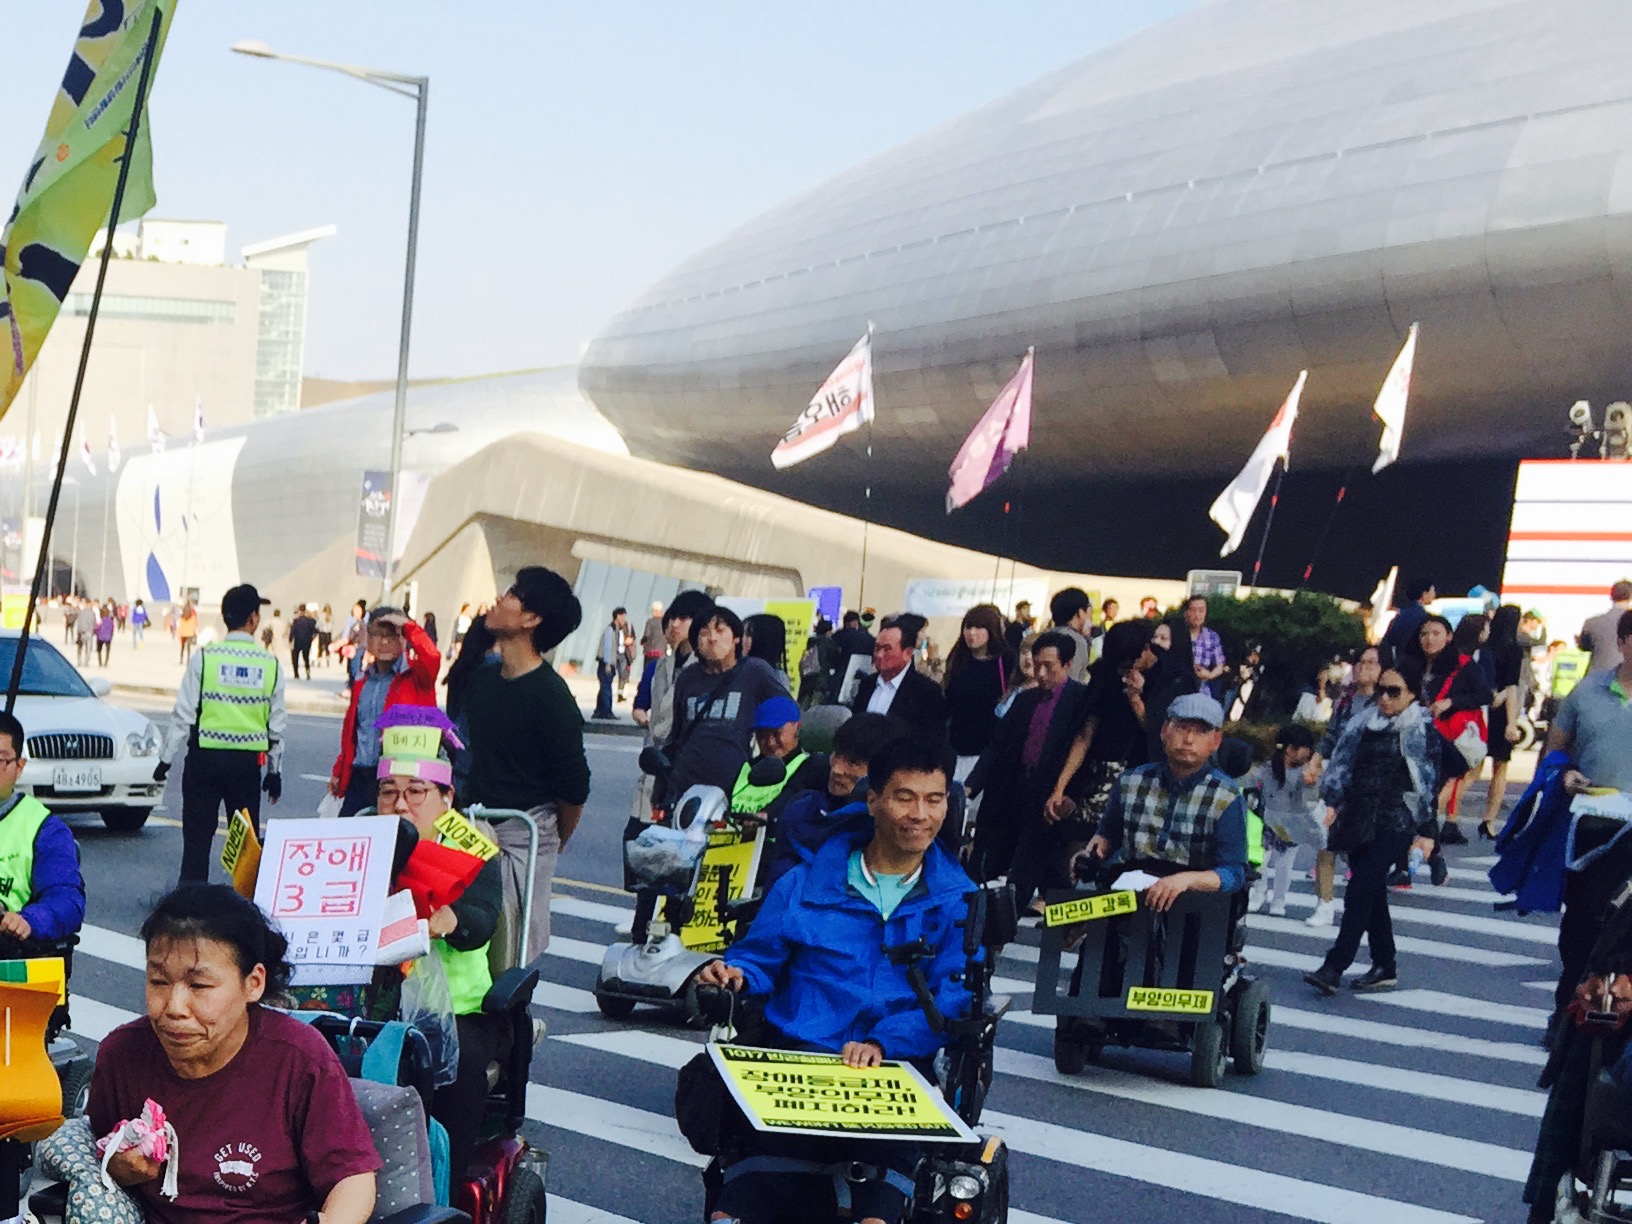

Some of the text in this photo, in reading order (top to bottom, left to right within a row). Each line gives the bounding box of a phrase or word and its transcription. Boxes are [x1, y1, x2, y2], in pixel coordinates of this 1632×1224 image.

[287, 841, 366, 876] 장애
[1048, 900, 1094, 923] 빈곤의
[1132, 990, 1209, 1011] 부양의무제
[755, 1083, 917, 1103] 부양의무제
[213, 1141, 262, 1162] GET USED
